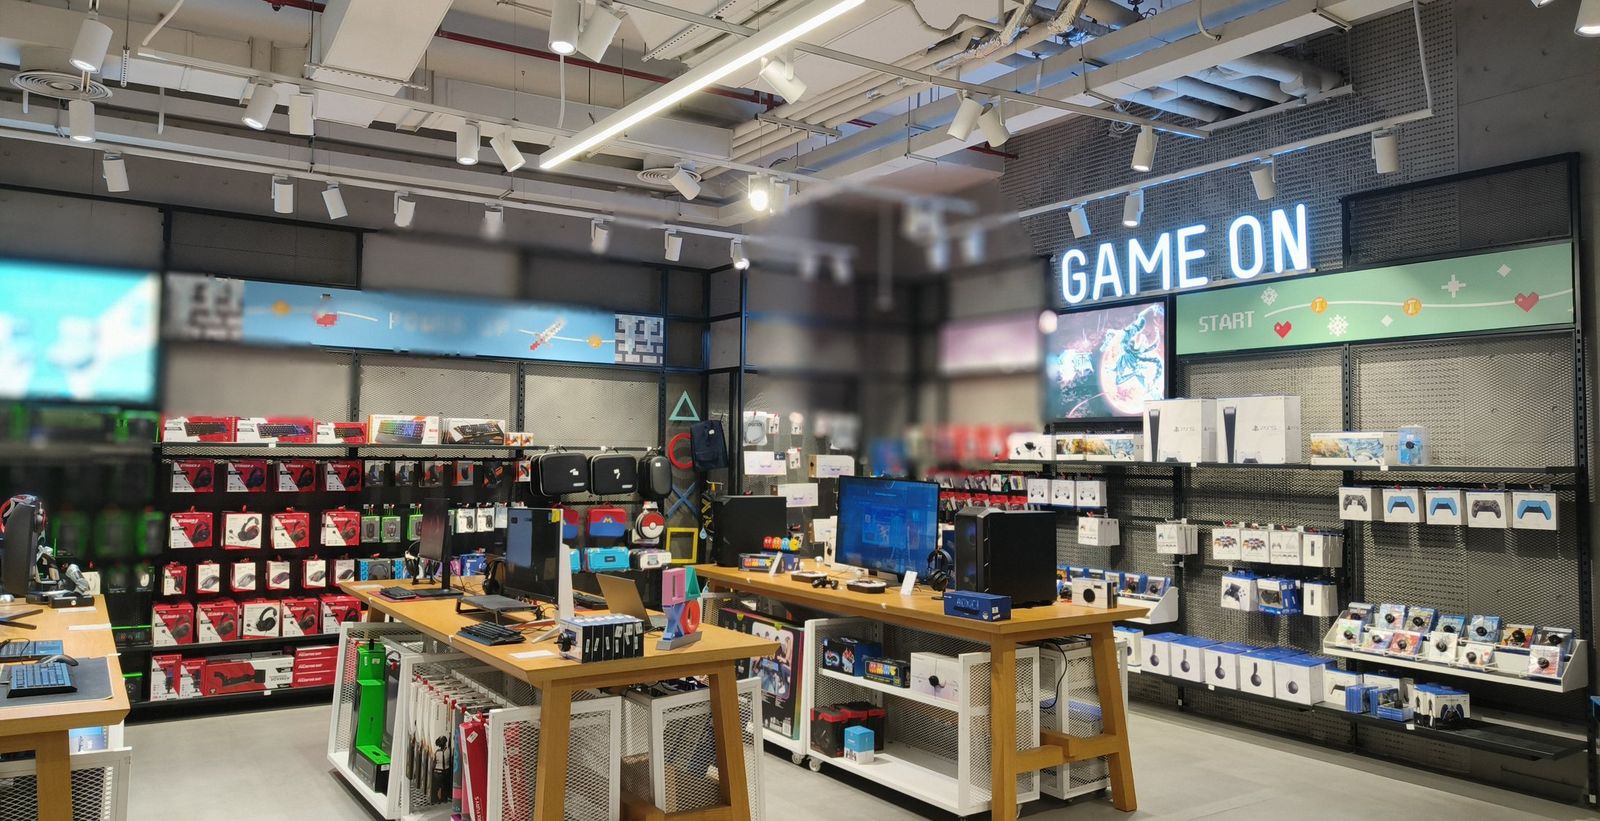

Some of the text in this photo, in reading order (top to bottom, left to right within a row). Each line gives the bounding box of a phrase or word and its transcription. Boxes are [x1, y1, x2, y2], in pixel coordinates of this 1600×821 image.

[1061, 203, 1309, 304] GAME ON
[1199, 310, 1255, 333] START
